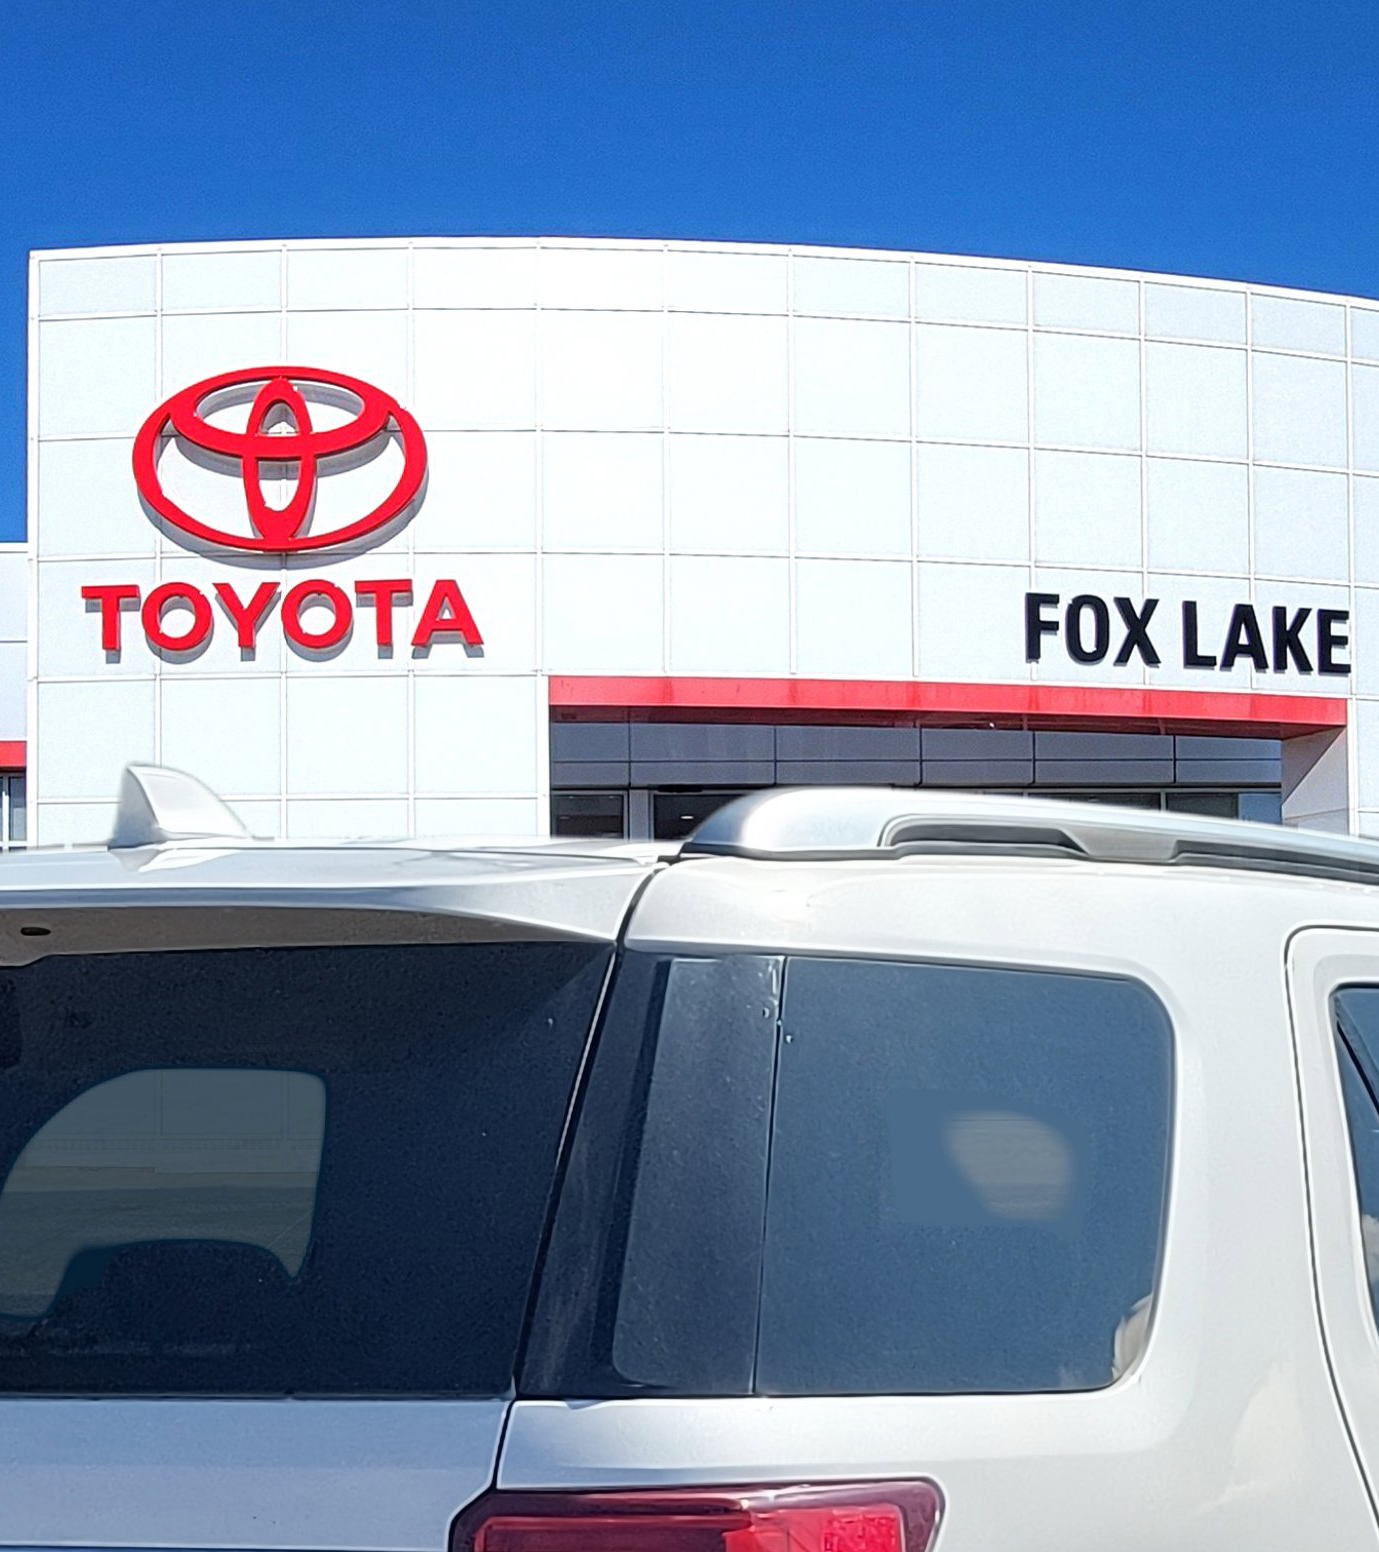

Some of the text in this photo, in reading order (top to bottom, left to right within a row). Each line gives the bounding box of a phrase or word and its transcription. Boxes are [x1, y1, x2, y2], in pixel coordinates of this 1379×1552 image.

[81, 579, 483, 657] TOYOTA
[1025, 592, 1352, 675] FOX LAKE
